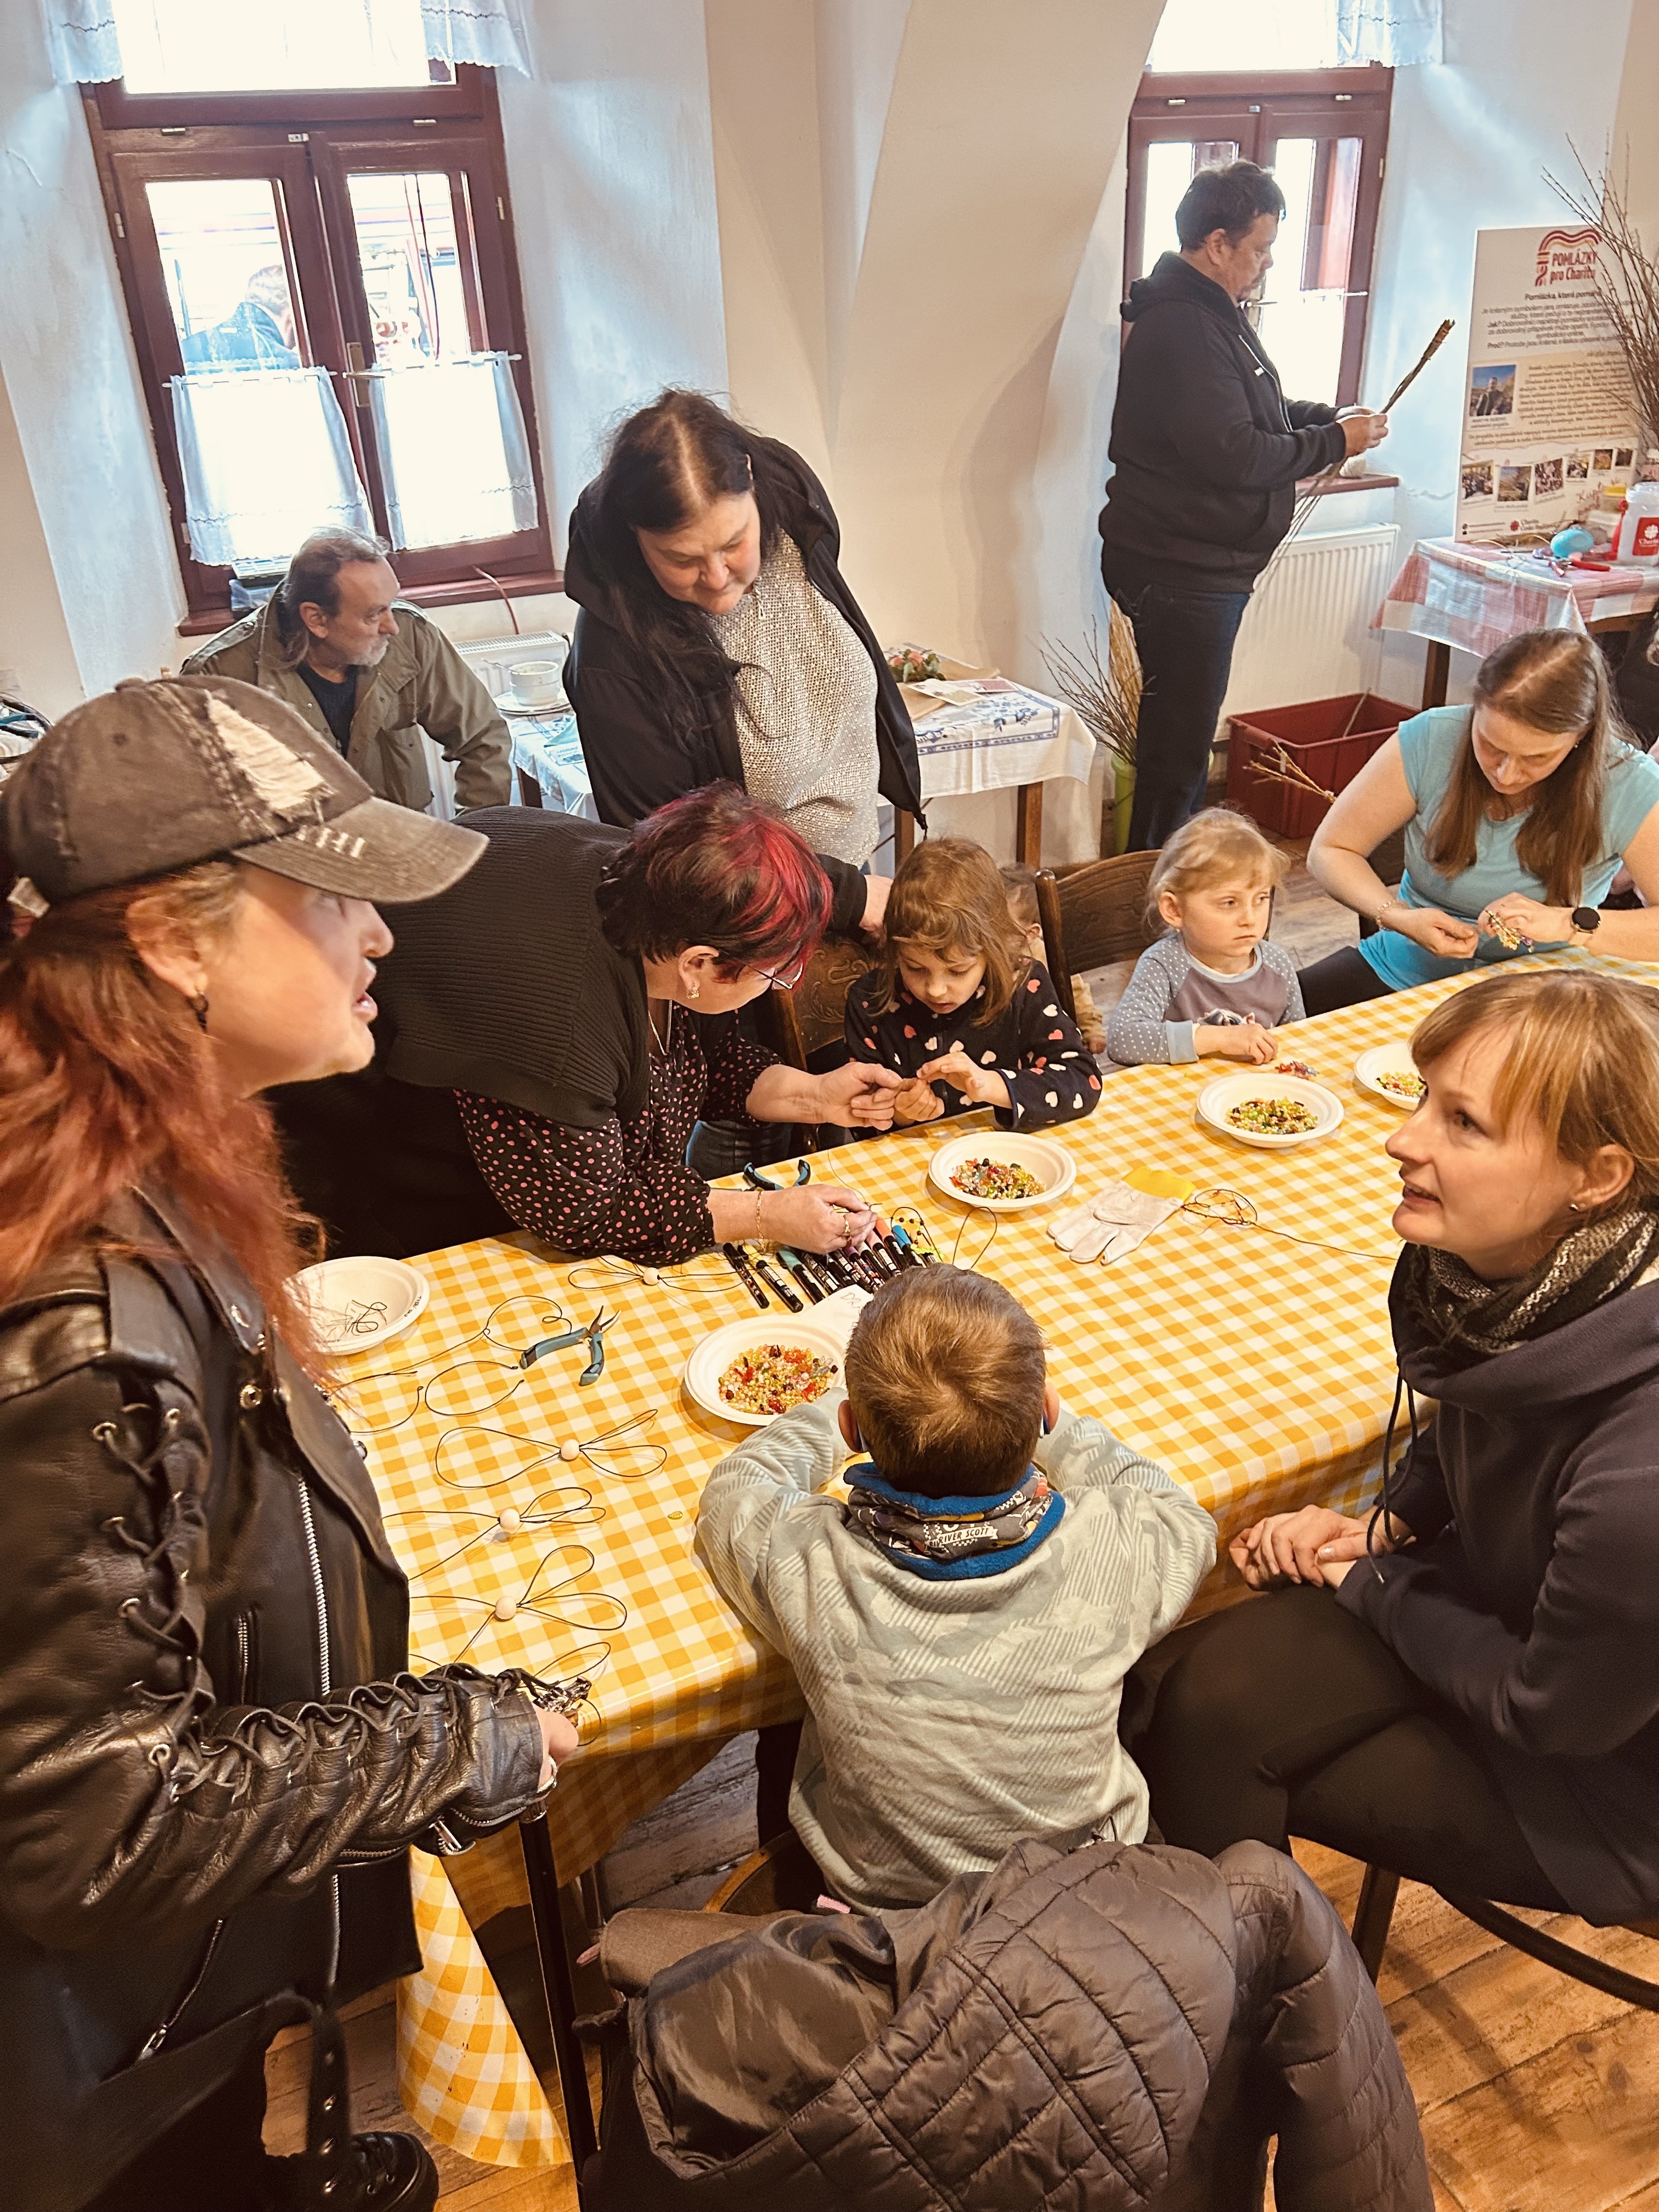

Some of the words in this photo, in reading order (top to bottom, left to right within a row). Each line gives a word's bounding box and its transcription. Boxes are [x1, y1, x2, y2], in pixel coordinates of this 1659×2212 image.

[1550, 270, 1564, 284] pro
[939, 1532, 962, 1544] RIVER
[966, 1527, 989, 1538] SCOTT
